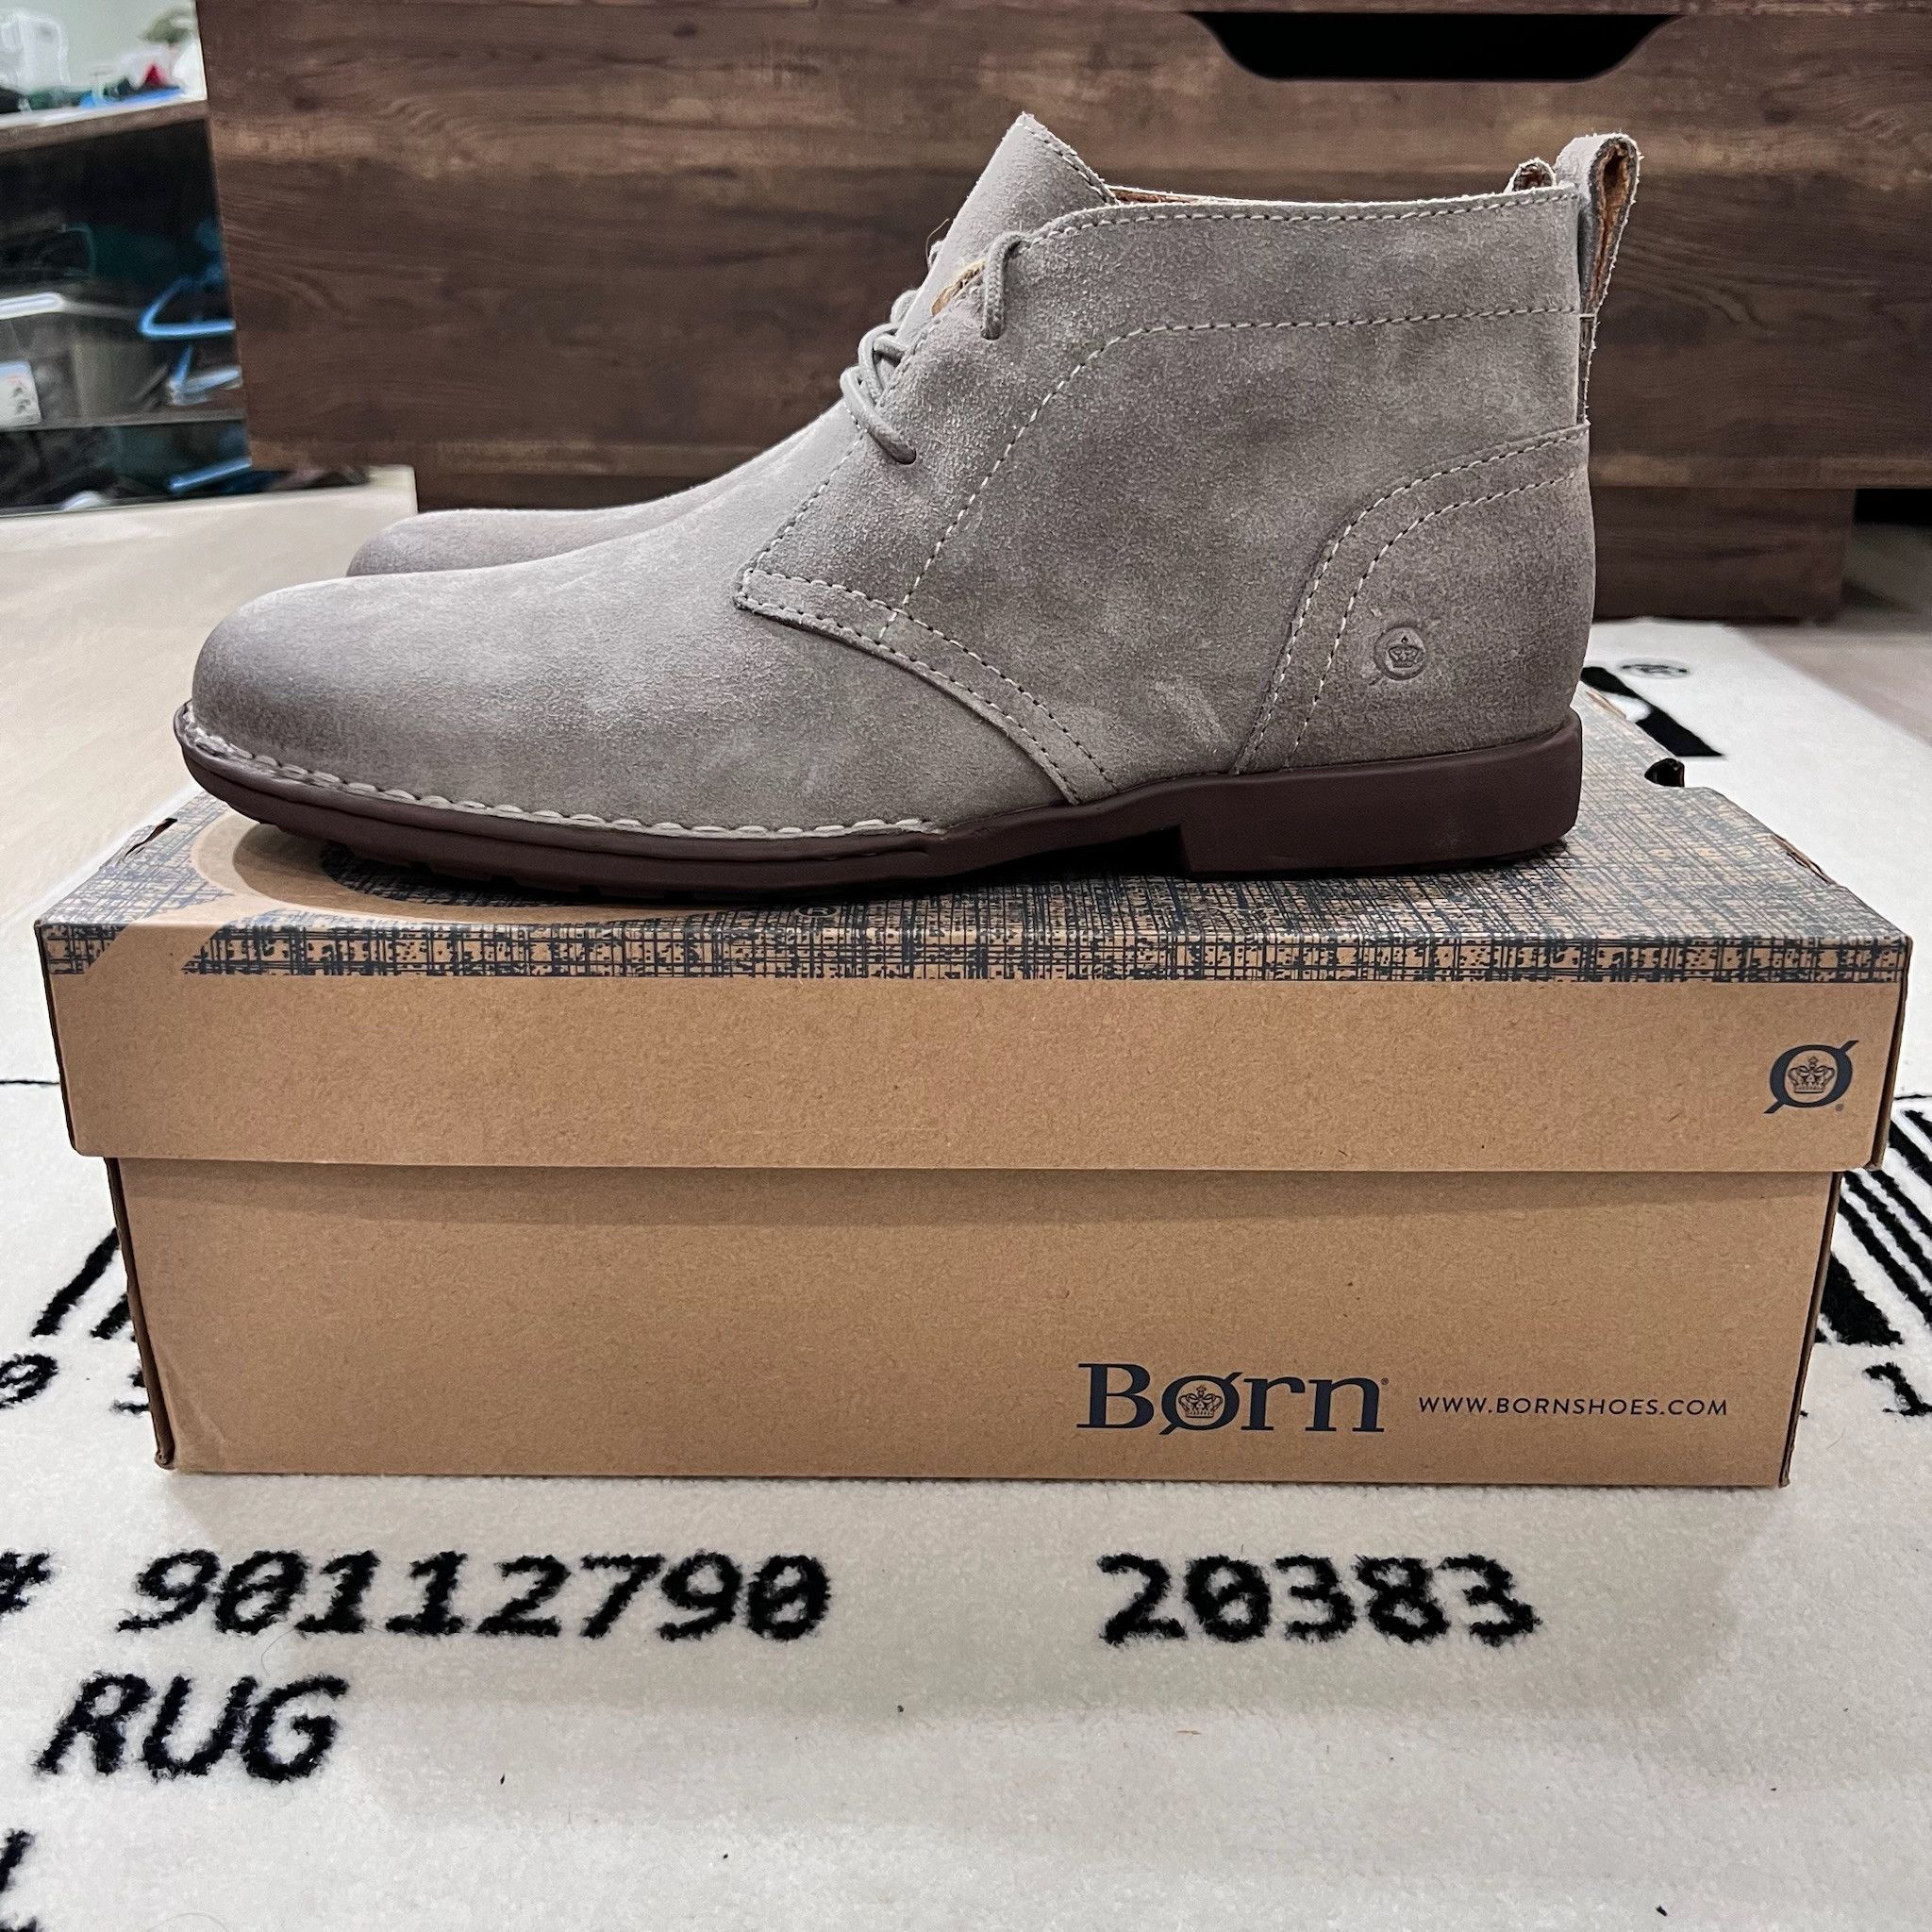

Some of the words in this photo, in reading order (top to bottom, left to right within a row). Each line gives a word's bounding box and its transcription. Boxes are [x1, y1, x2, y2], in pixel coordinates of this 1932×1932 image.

[1418, 1396, 1728, 1416] WWW.BORNSHOES.COM
[116, 1550, 831, 1642] 90112790
[1097, 1552, 1541, 1646] 20383
[34, 1671, 349, 1782] RUG
